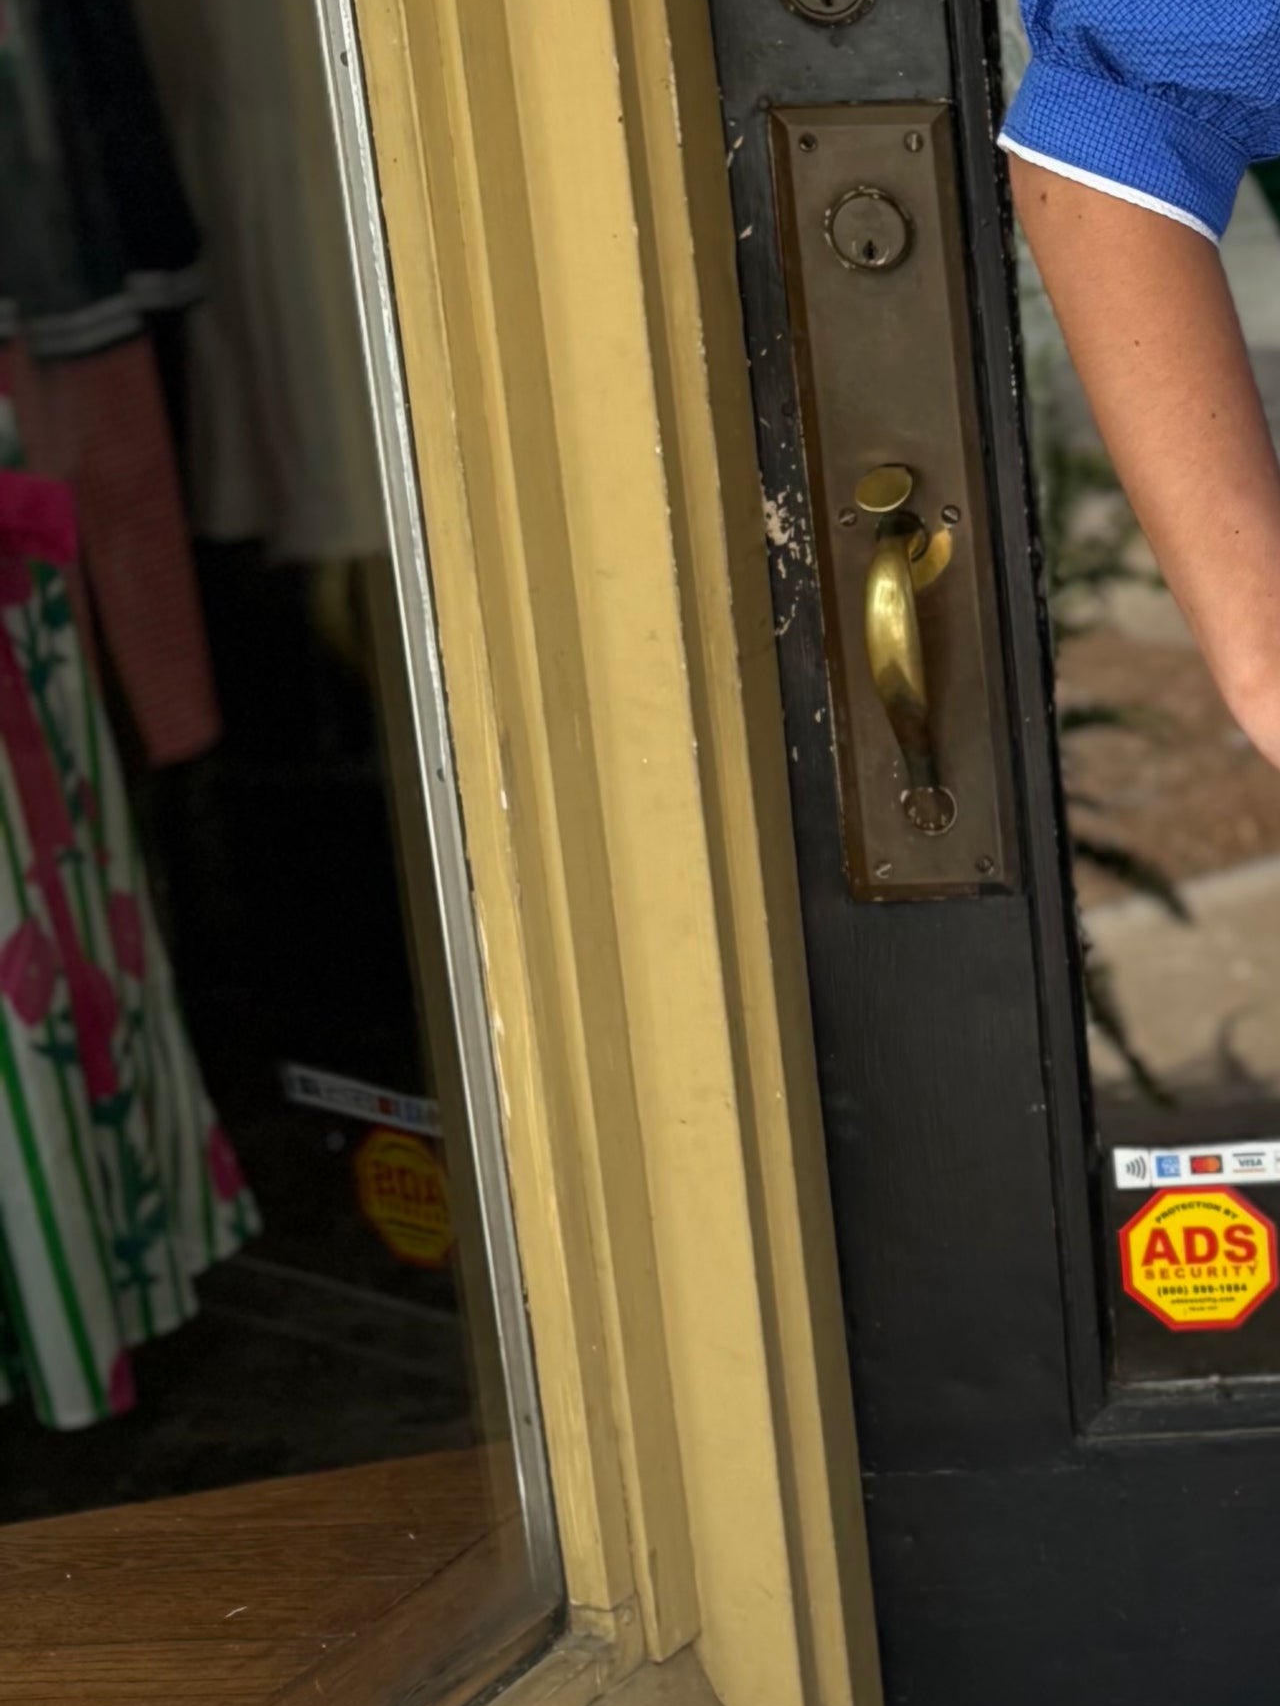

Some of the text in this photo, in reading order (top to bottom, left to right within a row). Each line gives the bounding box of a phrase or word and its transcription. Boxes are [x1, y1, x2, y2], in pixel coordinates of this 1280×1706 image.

[1155, 1201, 1238, 1223] PROTECTION BY
[1141, 1223, 1258, 1266] ADS
[1144, 1265, 1257, 1280] SECURITY
